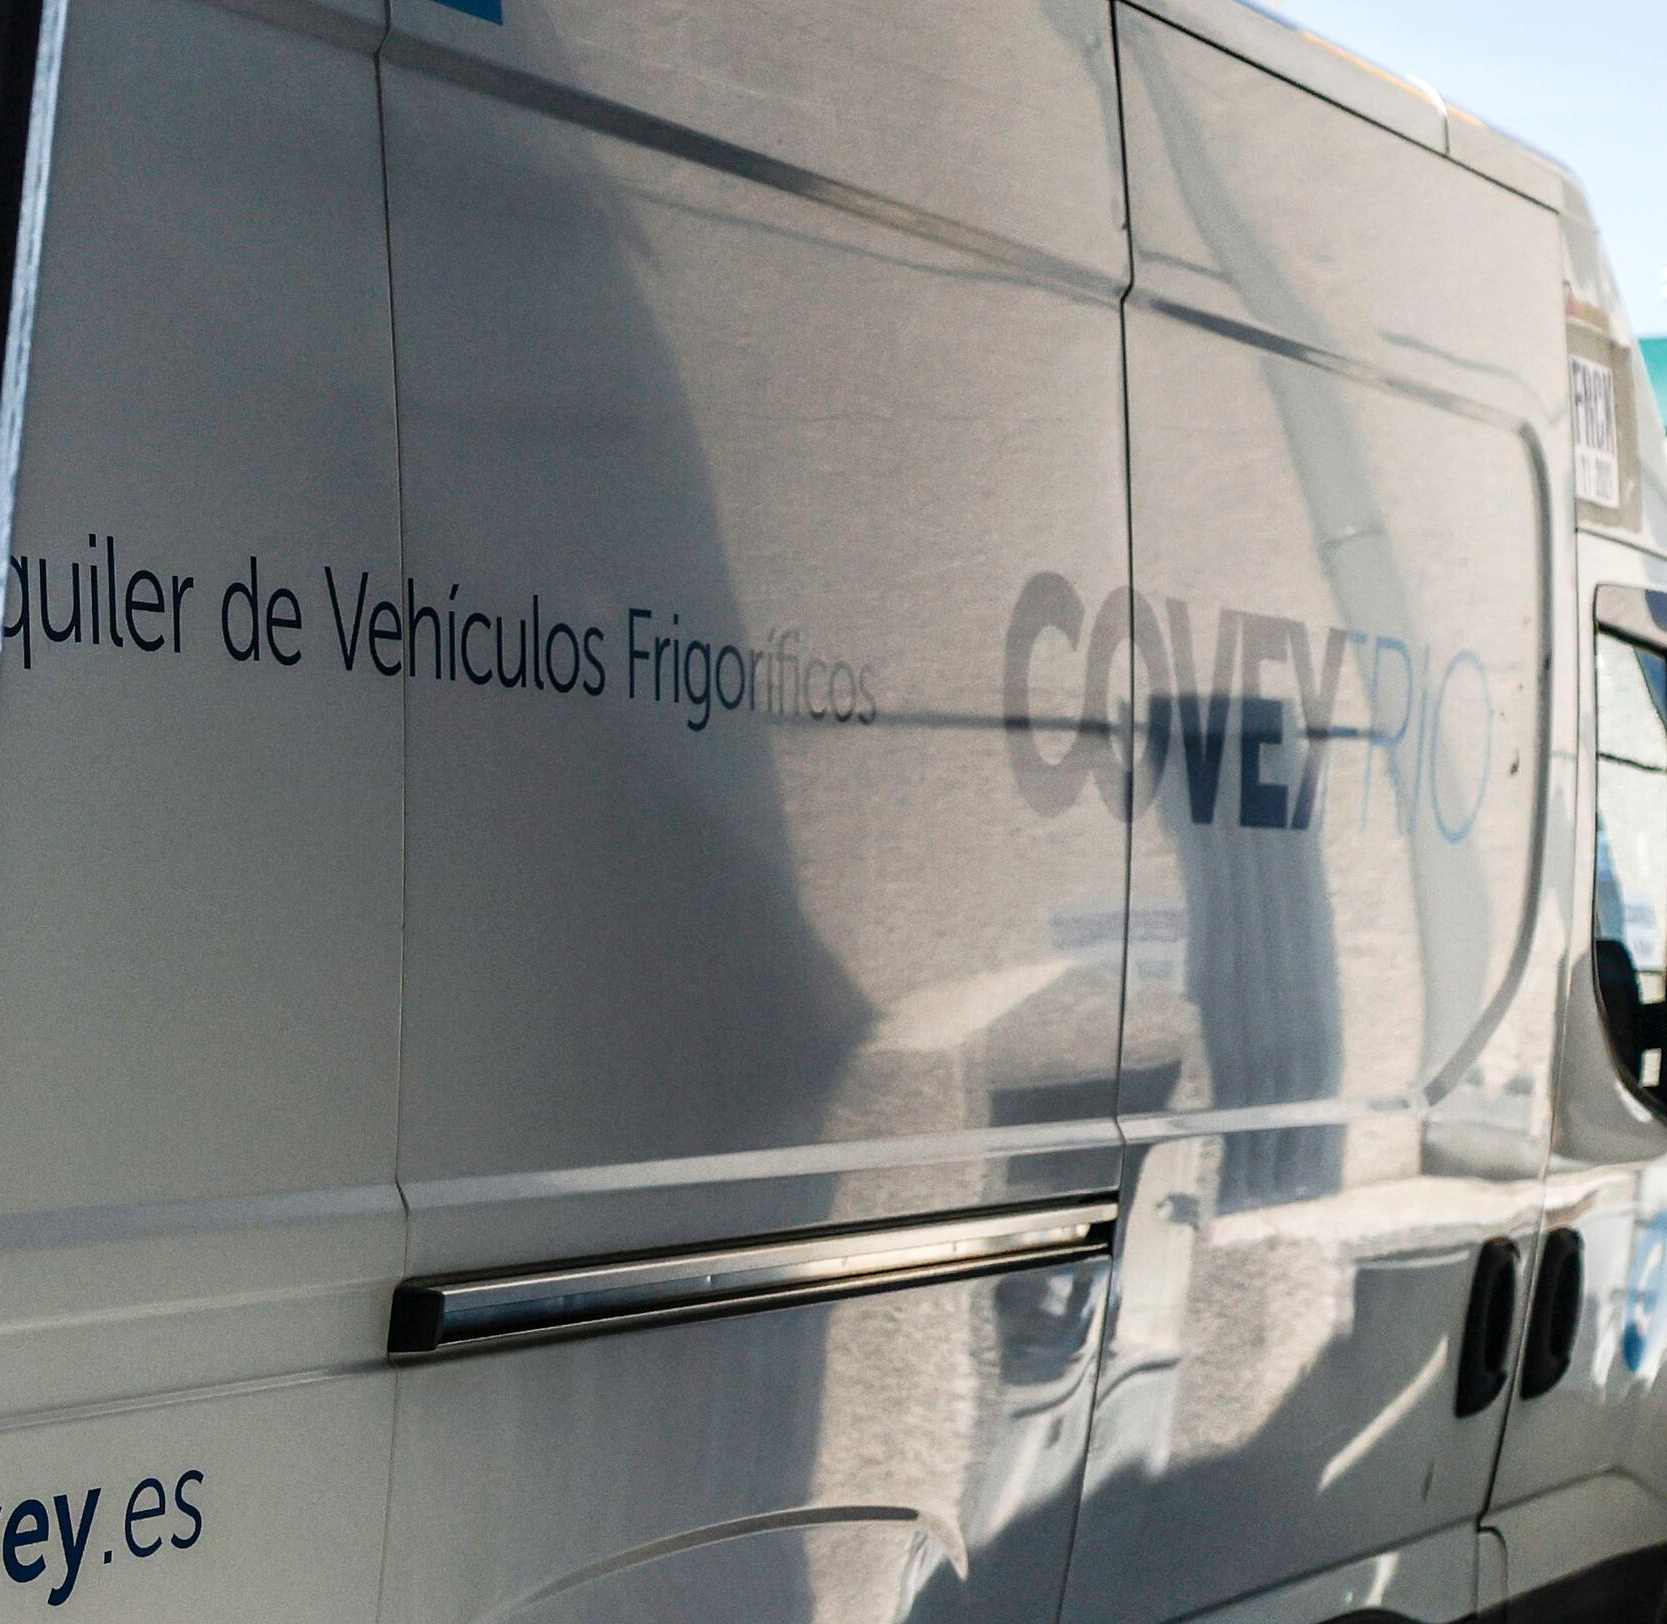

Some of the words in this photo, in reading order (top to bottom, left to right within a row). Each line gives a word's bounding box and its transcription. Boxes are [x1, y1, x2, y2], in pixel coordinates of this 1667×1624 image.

[222, 556, 302, 665] de
[324, 566, 606, 696] Vehículos
[629, 608, 877, 732] Frigoríficos
